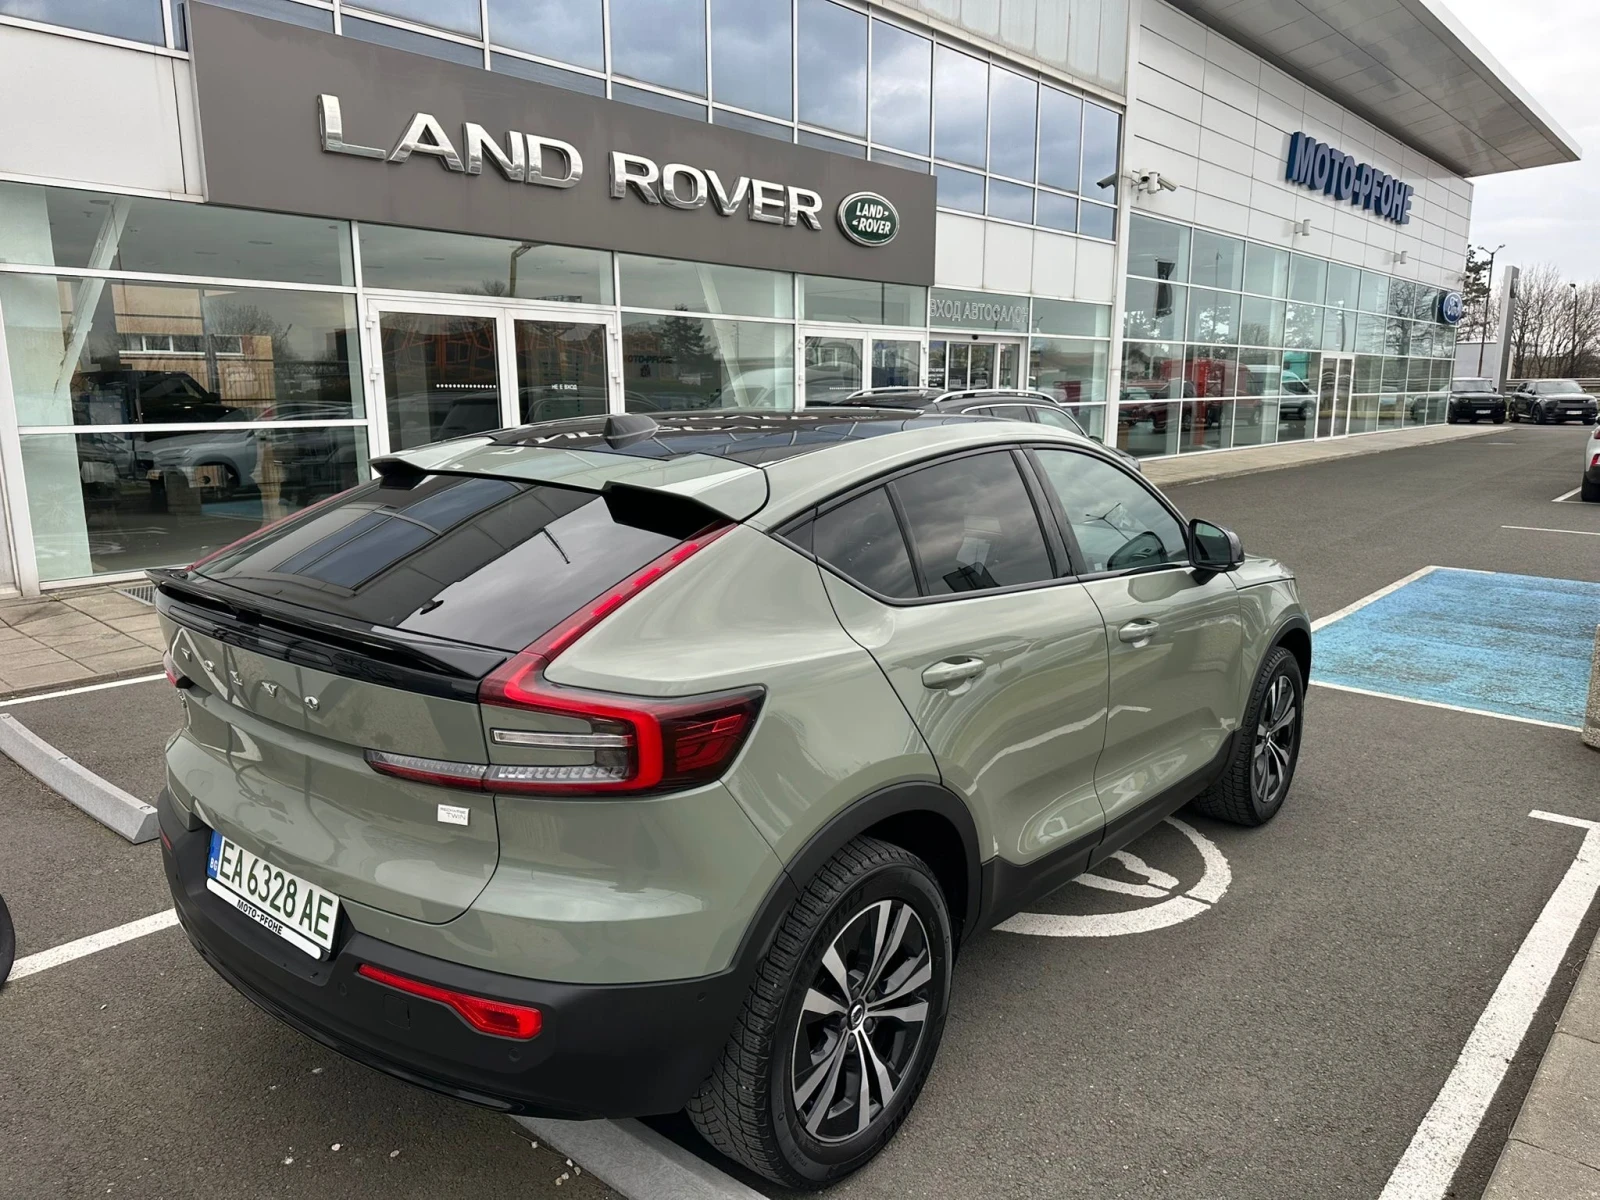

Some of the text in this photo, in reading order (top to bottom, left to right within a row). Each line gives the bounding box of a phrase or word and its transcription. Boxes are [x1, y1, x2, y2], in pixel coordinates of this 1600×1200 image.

[317, 94, 823, 230] LAND ROVER
[1286, 131, 1414, 224] MOTO-PFOHE
[858, 218, 891, 234] ROVER
[930, 299, 1029, 323] ВХОД АВТОСАЛОН
[446, 811, 466, 821] TWIN
[210, 857, 218, 871] BG
[220, 840, 333, 940] EA 6328 AE
[237, 900, 283, 935] MOTO-PFOHE
